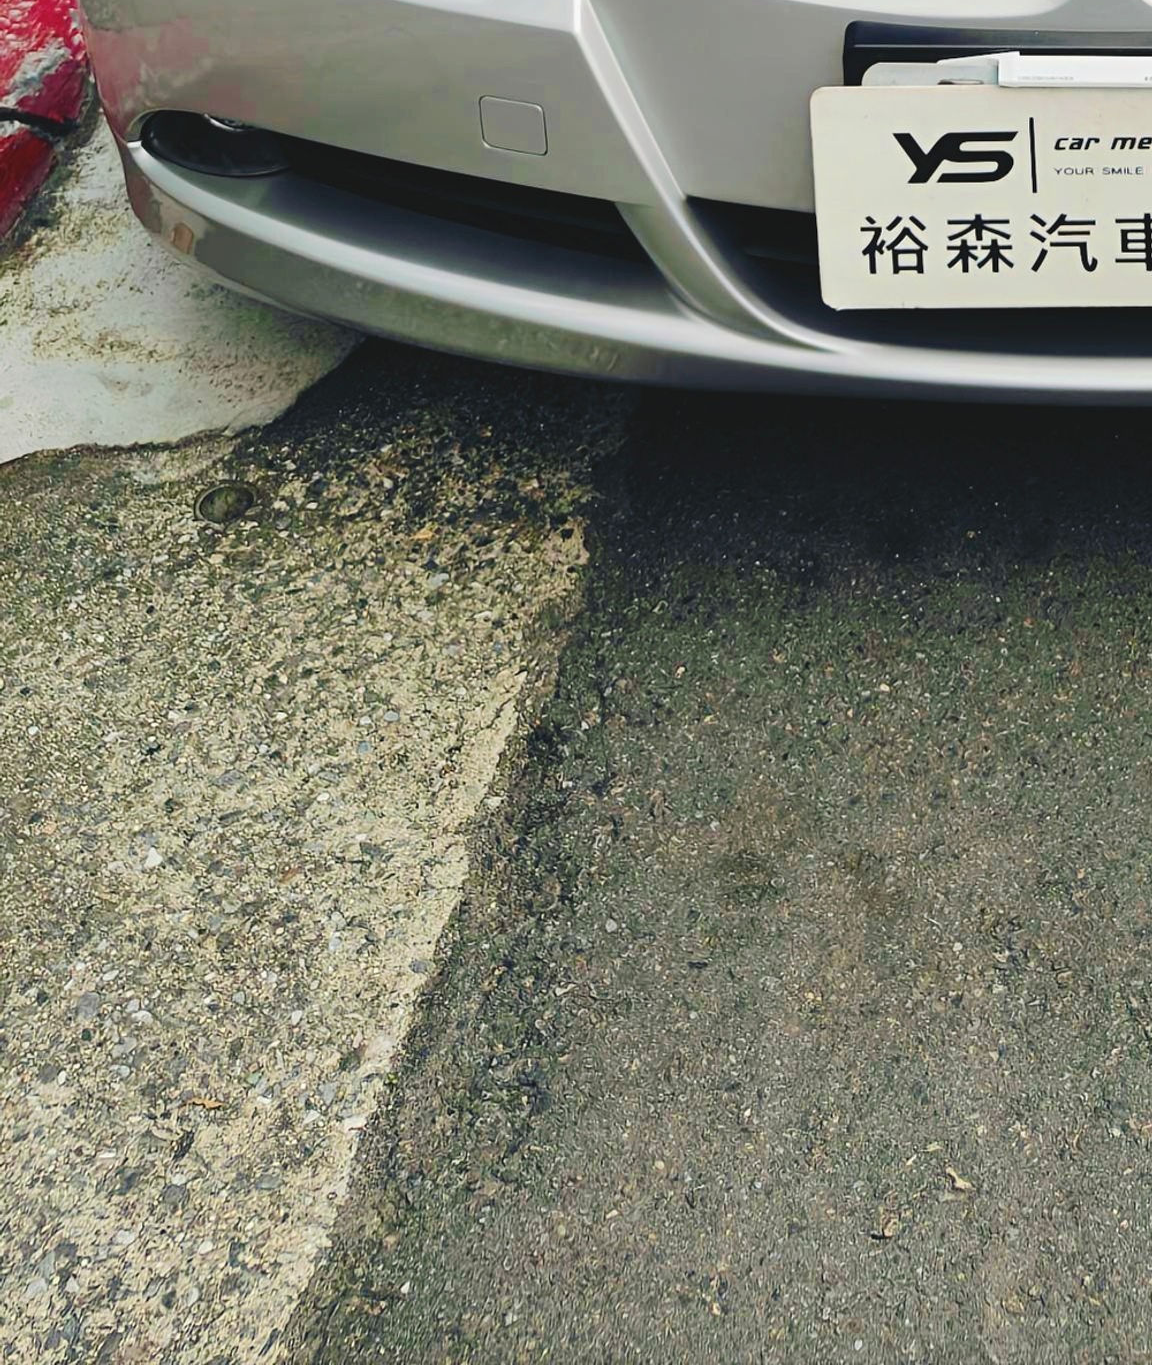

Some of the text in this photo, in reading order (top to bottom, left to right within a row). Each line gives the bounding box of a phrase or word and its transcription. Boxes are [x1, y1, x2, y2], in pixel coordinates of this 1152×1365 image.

[1054, 135, 1100, 151] car
[892, 131, 1019, 184] YS
[1054, 167, 1095, 176] YOUR
[1102, 166, 1144, 175] SMILE
